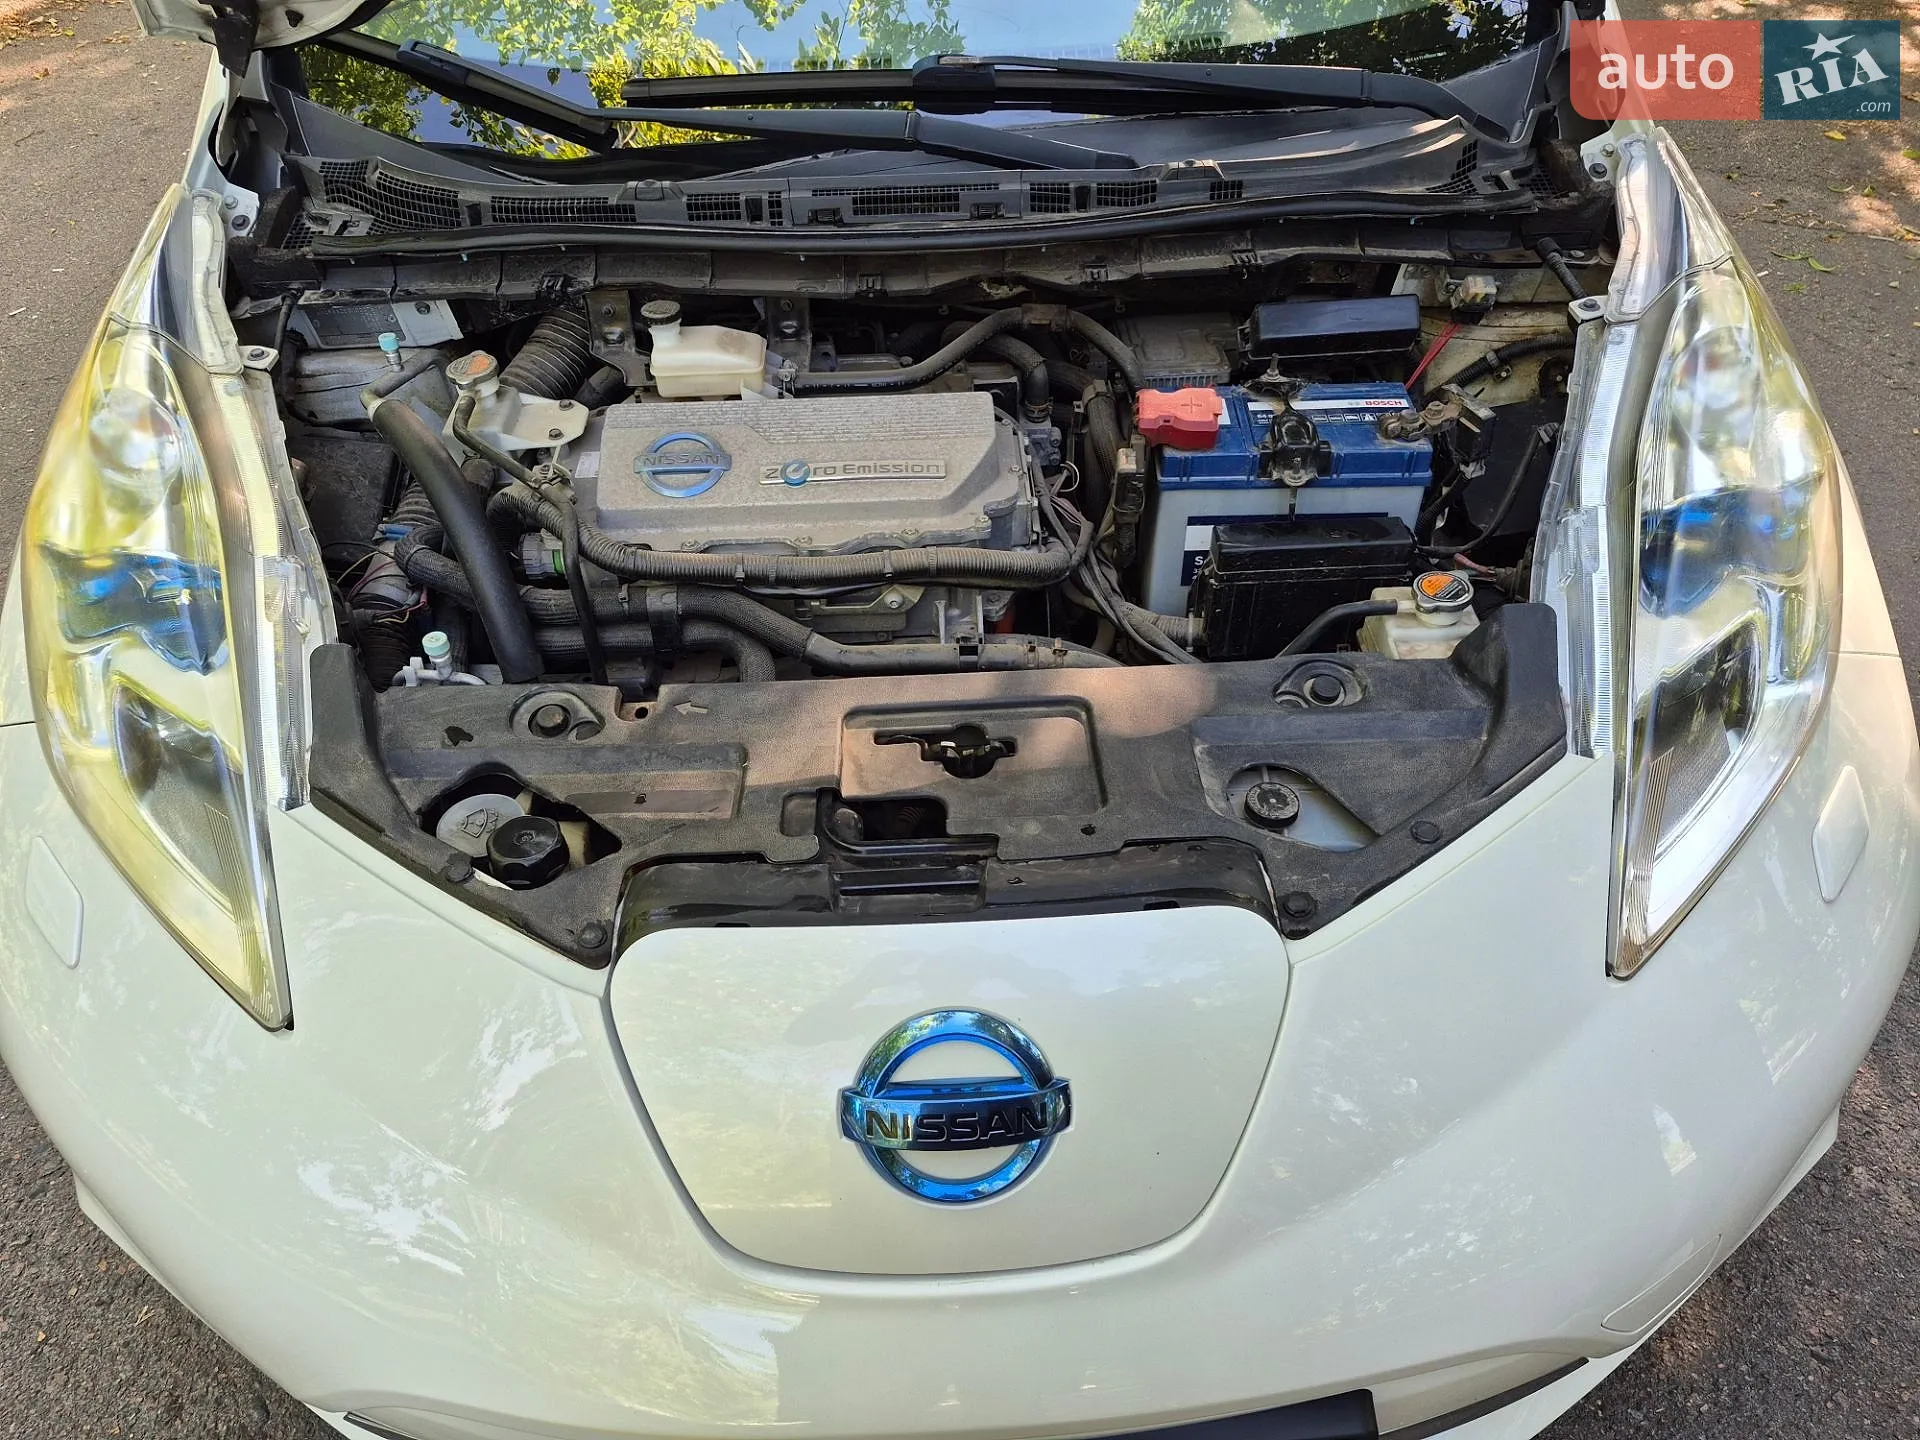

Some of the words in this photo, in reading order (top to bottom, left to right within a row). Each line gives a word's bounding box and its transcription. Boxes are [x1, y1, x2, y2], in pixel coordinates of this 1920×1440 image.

[643, 454, 721, 466] NISSAN
[842, 463, 940, 475] Emission
[865, 1103, 1049, 1142] NISSAN
